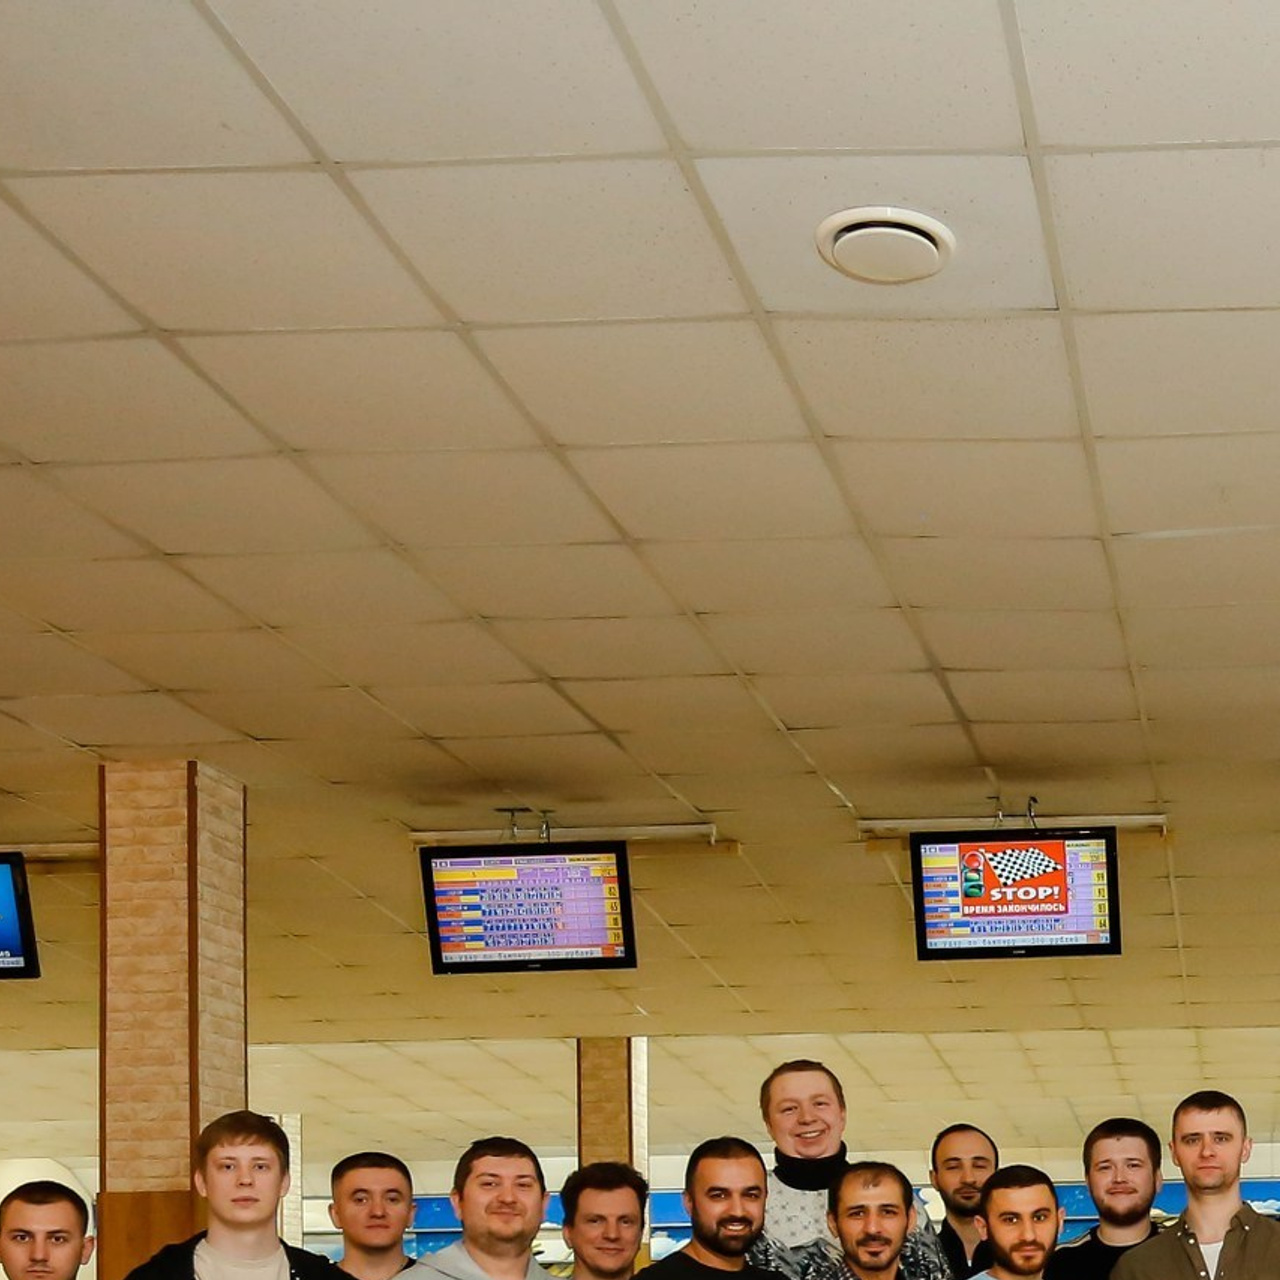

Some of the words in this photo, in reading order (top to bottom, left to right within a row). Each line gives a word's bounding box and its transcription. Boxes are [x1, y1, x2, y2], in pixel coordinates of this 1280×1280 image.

[989, 886, 1061, 901] STOP!
[964, 905, 997, 915] ВРЕМЯ
[997, 903, 1066, 914] ЗАКОНЧИЛОСЬ
